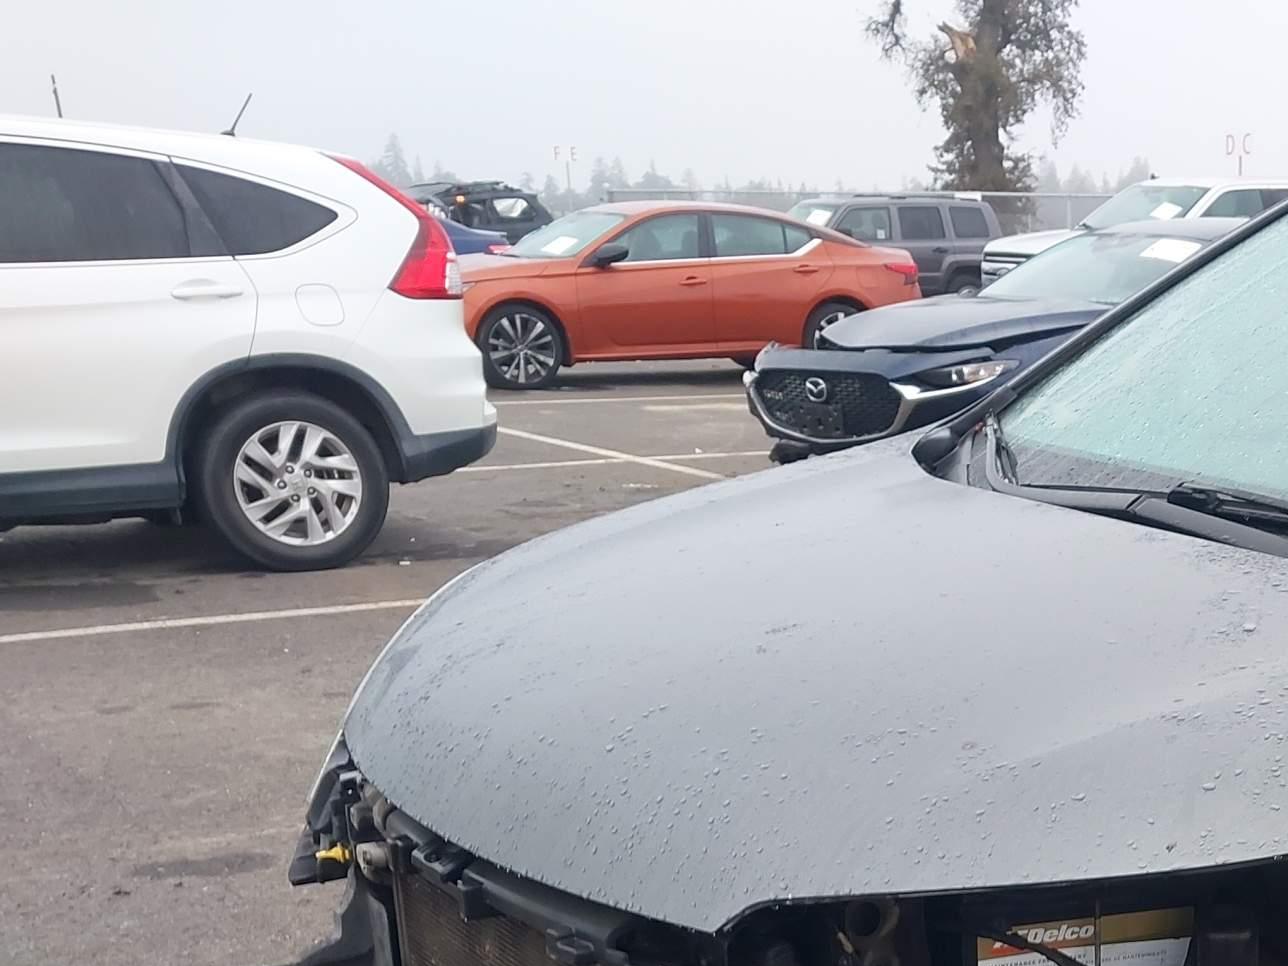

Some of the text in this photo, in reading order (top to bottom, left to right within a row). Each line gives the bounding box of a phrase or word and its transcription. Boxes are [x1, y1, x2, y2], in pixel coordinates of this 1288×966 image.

[1226, 133, 1251, 155] D C
[993, 923, 1095, 949] Delco
